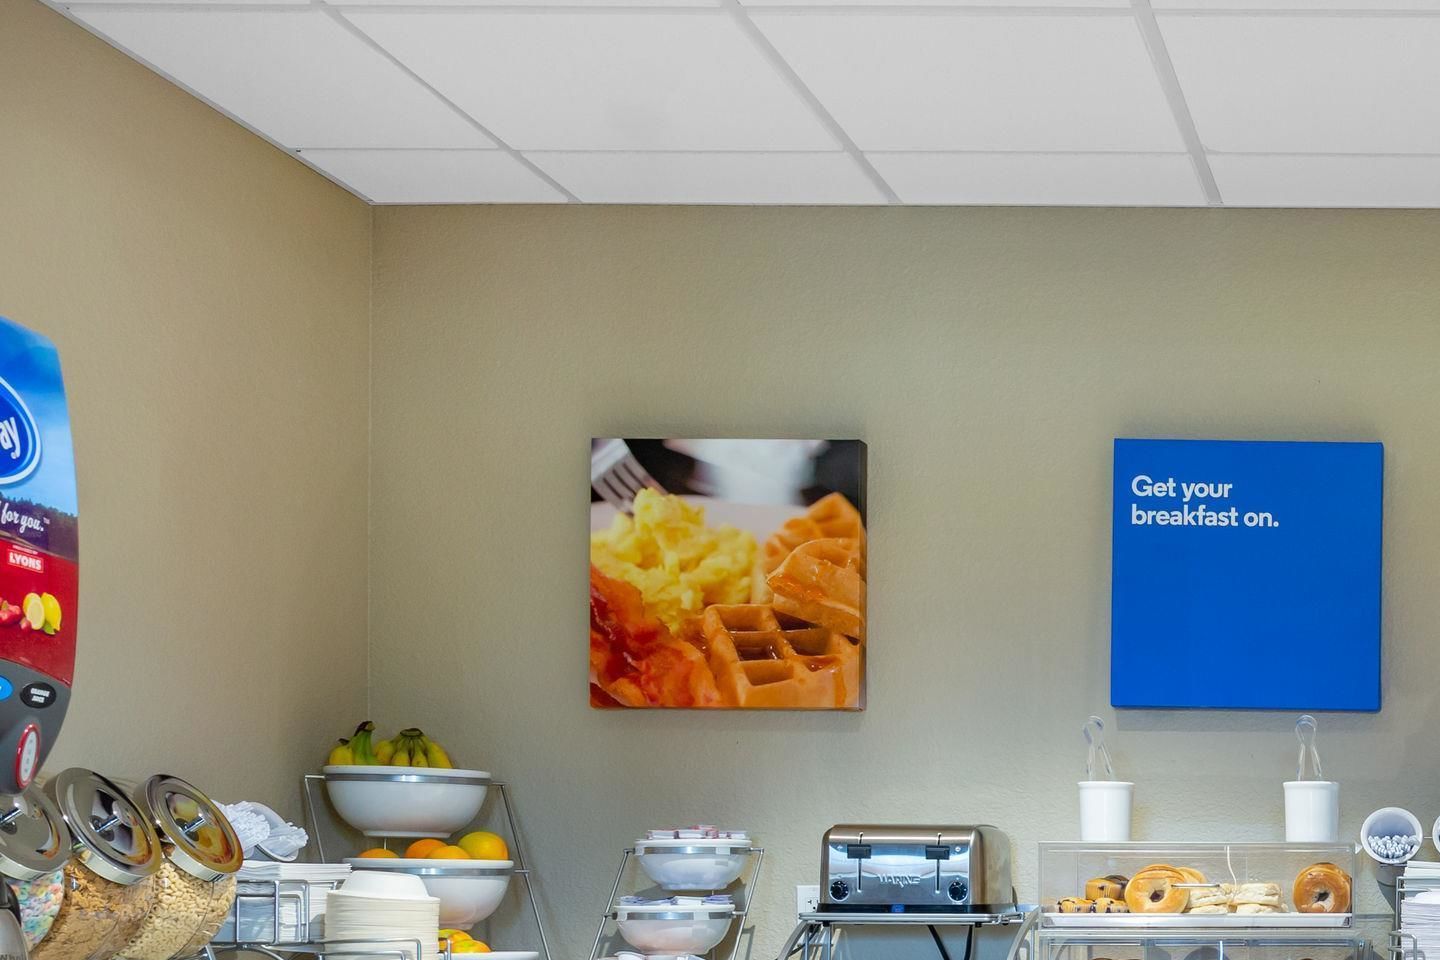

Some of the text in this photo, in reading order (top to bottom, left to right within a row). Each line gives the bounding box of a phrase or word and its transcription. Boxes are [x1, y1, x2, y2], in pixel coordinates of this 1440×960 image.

[1131, 475, 1233, 502] Get your
[1, 503, 20, 524] for
[1131, 503, 1280, 527] breakfast on.
[9, 552, 42, 571] LYONS
